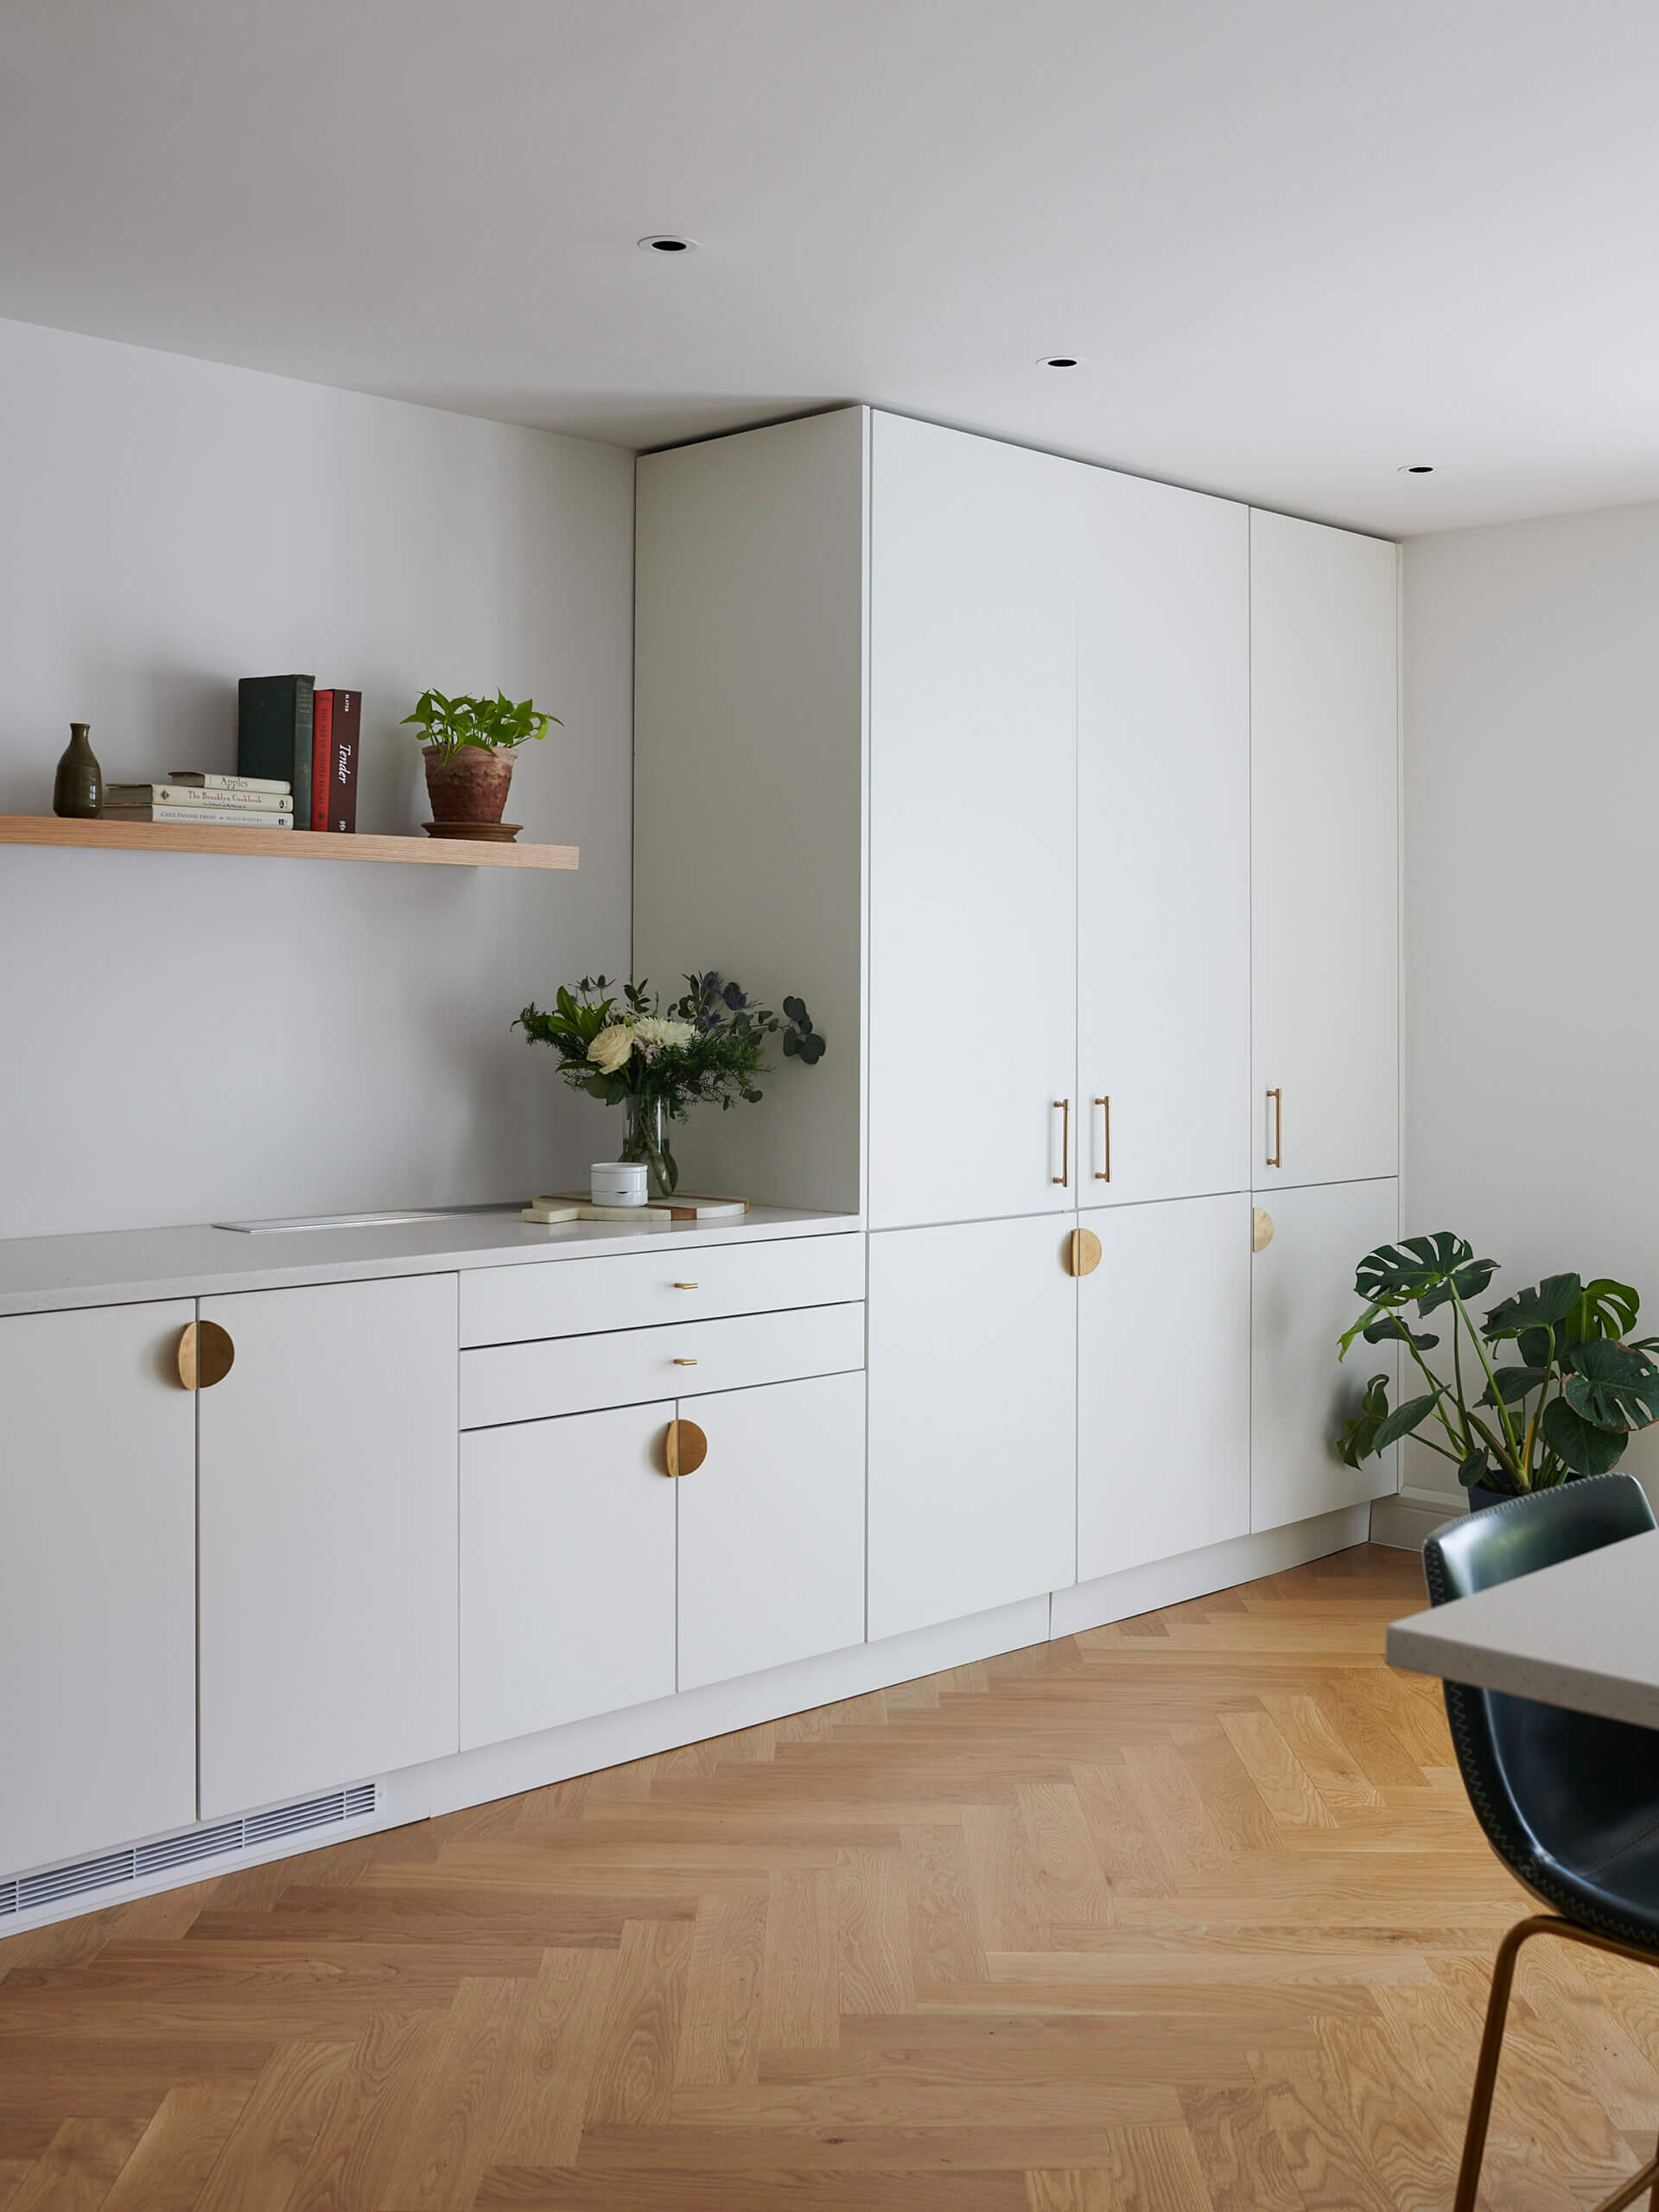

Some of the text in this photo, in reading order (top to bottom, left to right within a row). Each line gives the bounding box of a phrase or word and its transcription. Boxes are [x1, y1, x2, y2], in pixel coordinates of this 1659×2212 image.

[339, 744, 352, 784] Tender
[220, 777, 248, 788] Apples
[188, 791, 262, 803] The Brooklyn Cookbook
